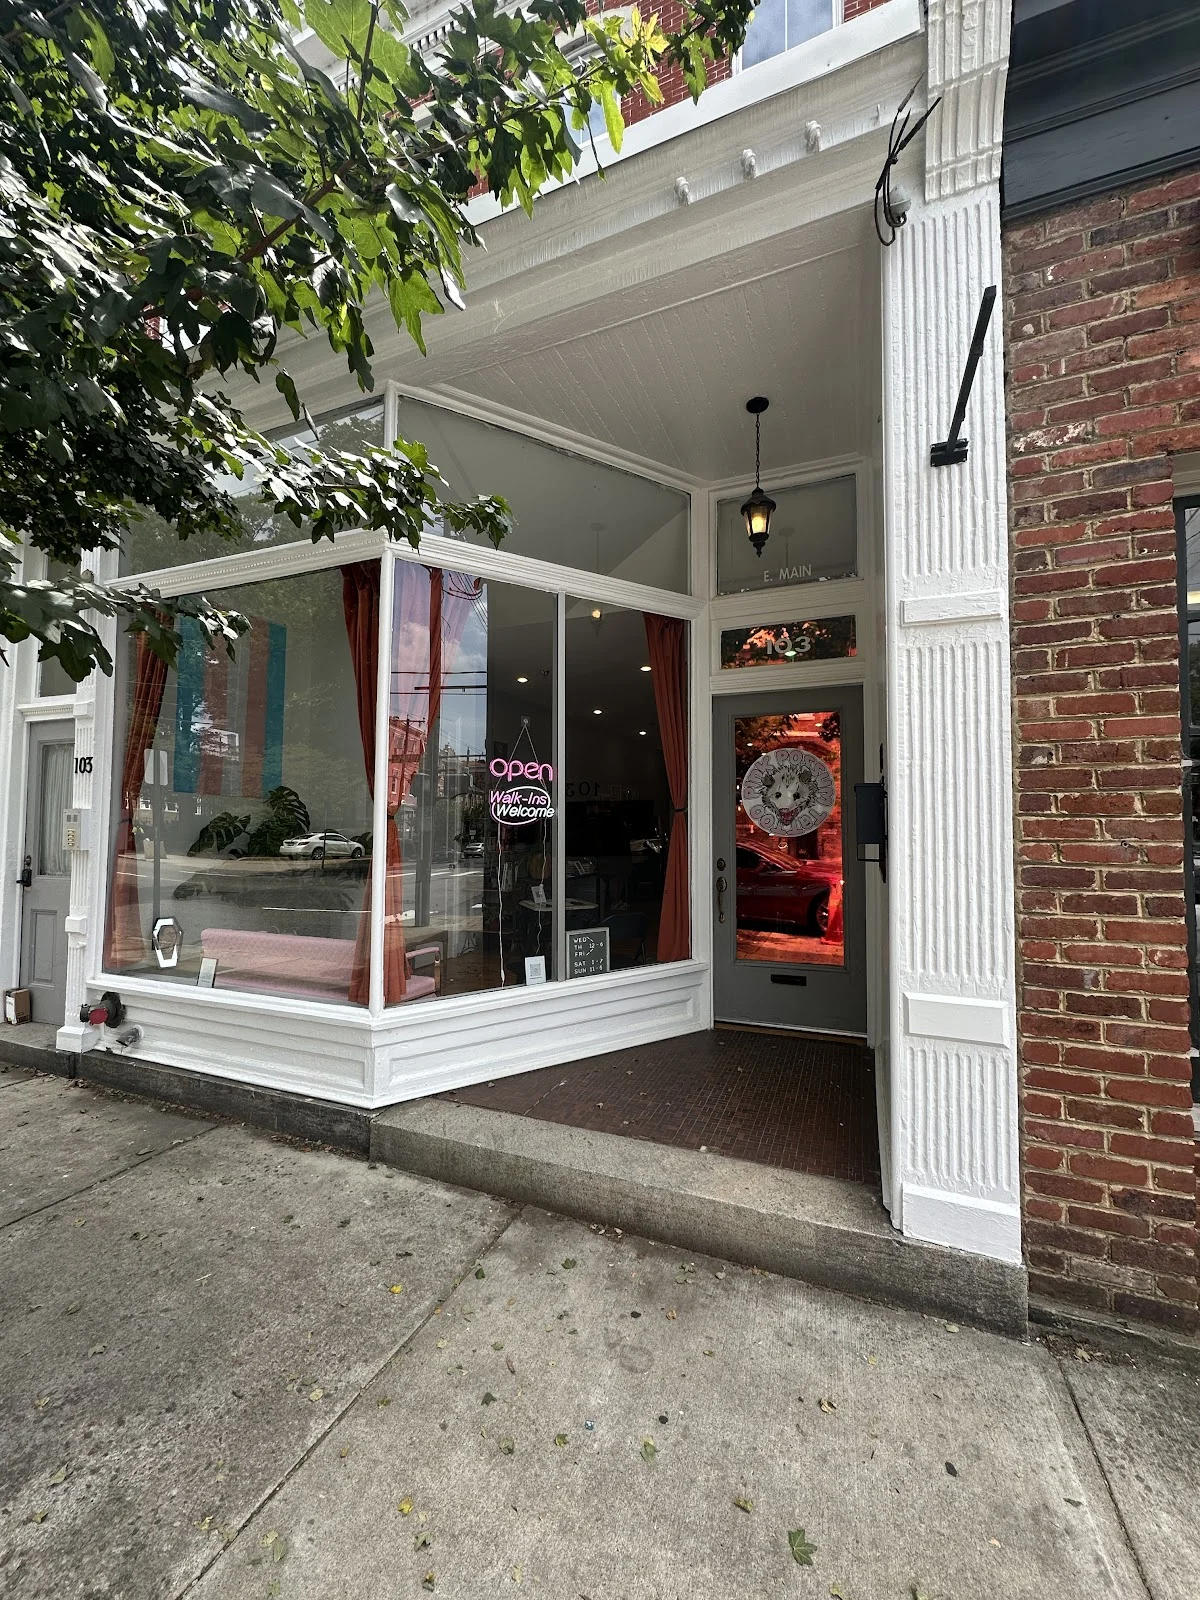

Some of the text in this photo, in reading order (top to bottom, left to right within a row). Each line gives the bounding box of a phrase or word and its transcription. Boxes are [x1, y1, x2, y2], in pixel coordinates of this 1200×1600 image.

[763, 564, 812, 582] E. MAIN
[765, 635, 812, 655] 103
[74, 756, 94, 774] 103
[490, 758, 553, 782] open
[490, 790, 548, 806] Walk-Ins
[495, 803, 555, 818] Welcome
